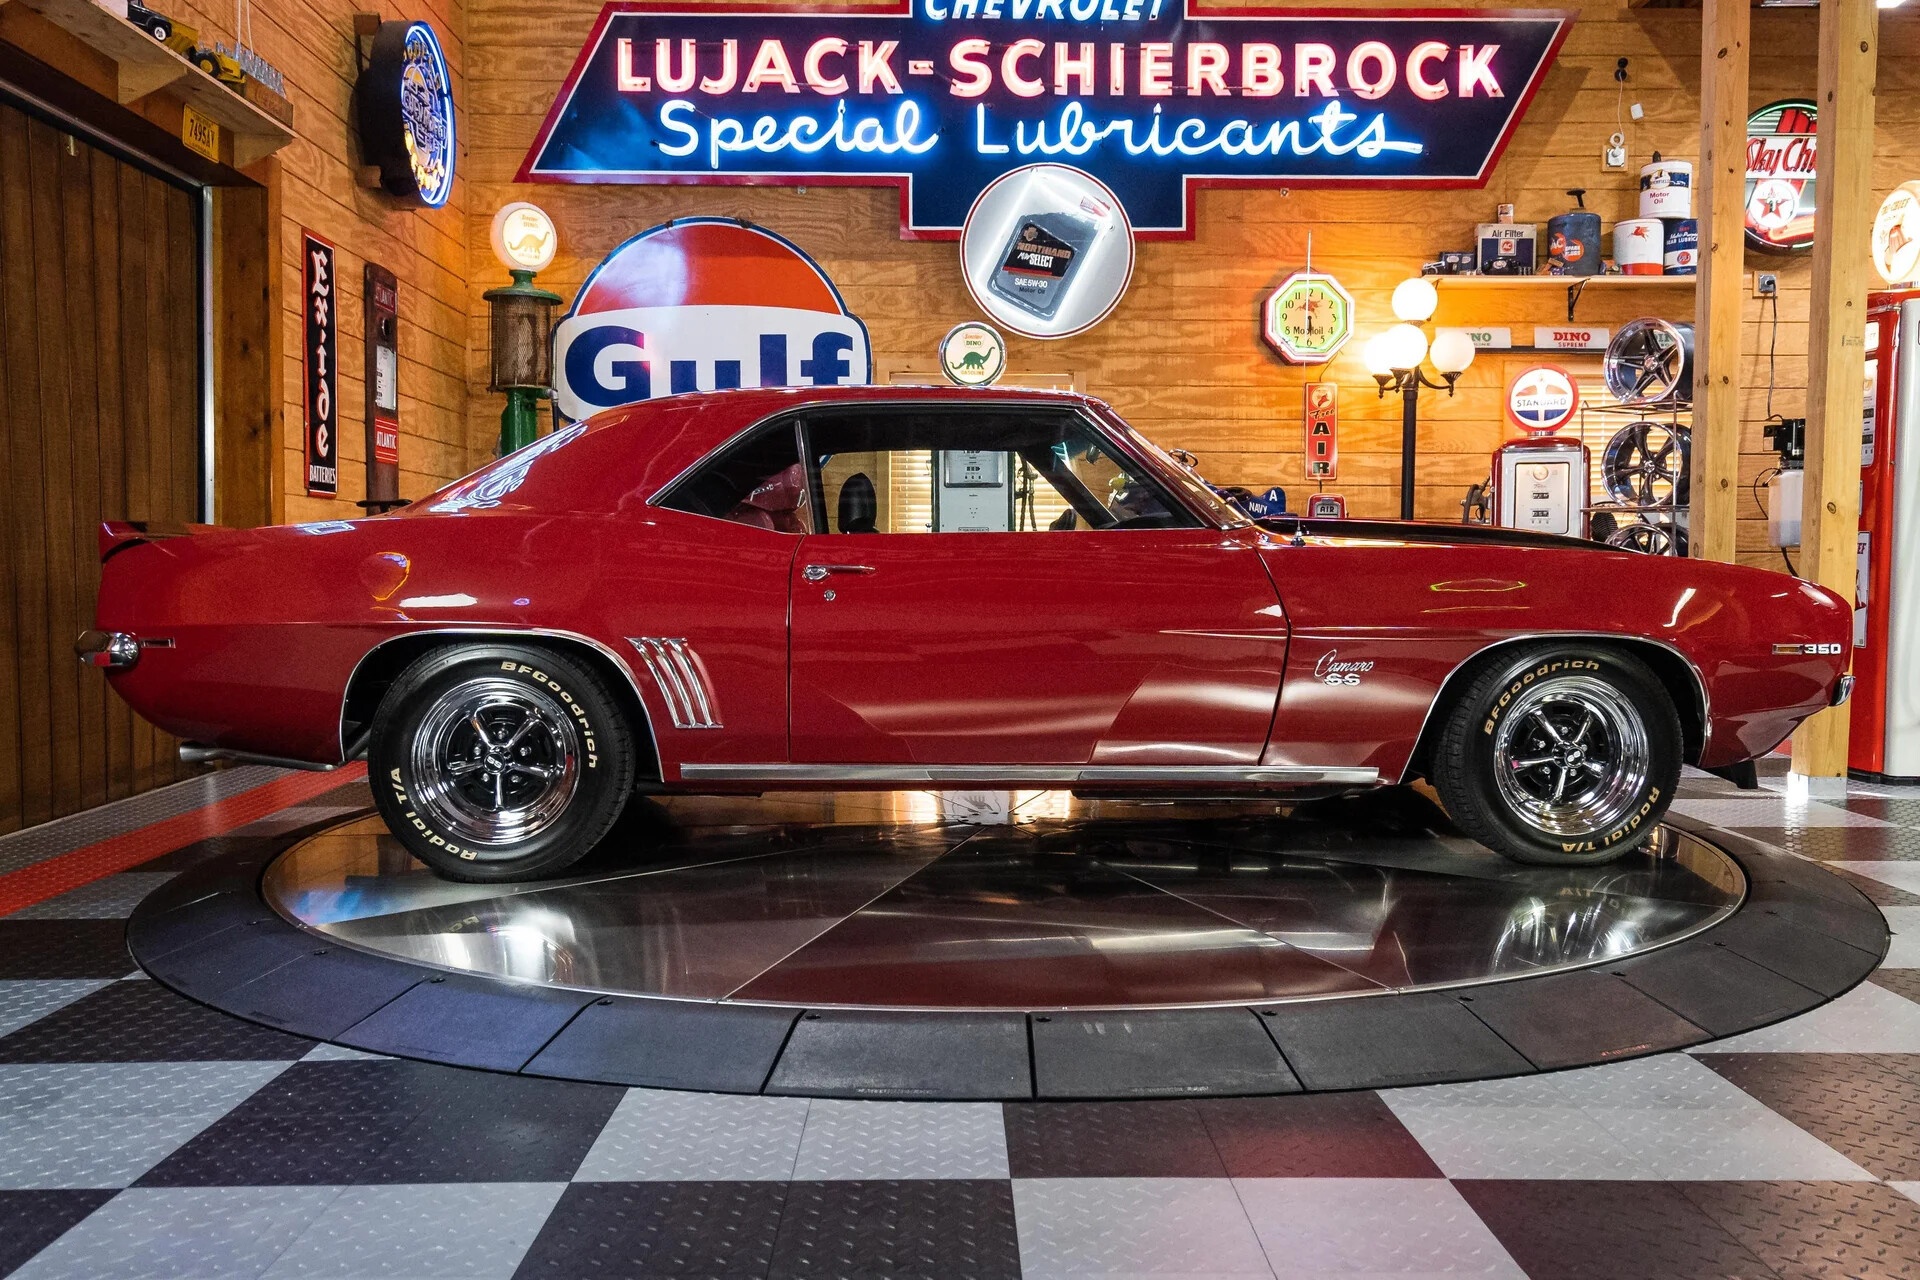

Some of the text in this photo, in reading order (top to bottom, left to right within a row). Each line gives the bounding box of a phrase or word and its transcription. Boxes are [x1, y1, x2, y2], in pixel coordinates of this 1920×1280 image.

[924, 0, 1163, 20] CHEVROLET
[657, 98, 1423, 169] Special Lubricants
[1745, 137, 1783, 177] Sky
[1649, 191, 1670, 199] Motor
[1017, 242, 1071, 259] NORTHLAND
[1550, 238, 1564, 249] AC
[1029, 253, 1054, 268] SELECT
[1014, 278, 1029, 286] SAE
[1019, 286, 1036, 294] Motor
[1553, 332, 1591, 341] DINO
[565, 325, 853, 407] Gulf
[376, 434, 397, 450] ATLANTIC
[1313, 422, 1330, 475] AIR
[309, 464, 336, 485] BATTERIES
[1269, 490, 1278, 501] A
[1249, 502, 1267, 514] NAVY
[1320, 504, 1335, 512] AIR
[1804, 643, 1841, 655] 350
[1314, 649, 1374, 677] Camaro
[1323, 673, 1361, 686] SS
[1484, 659, 1600, 735] BFGoodrich
[501, 660, 596, 769] BFGoodrich
[390, 767, 407, 805] T/A
[1561, 786, 1660, 854] Radial T/A
[406, 811, 478, 861] Radial
